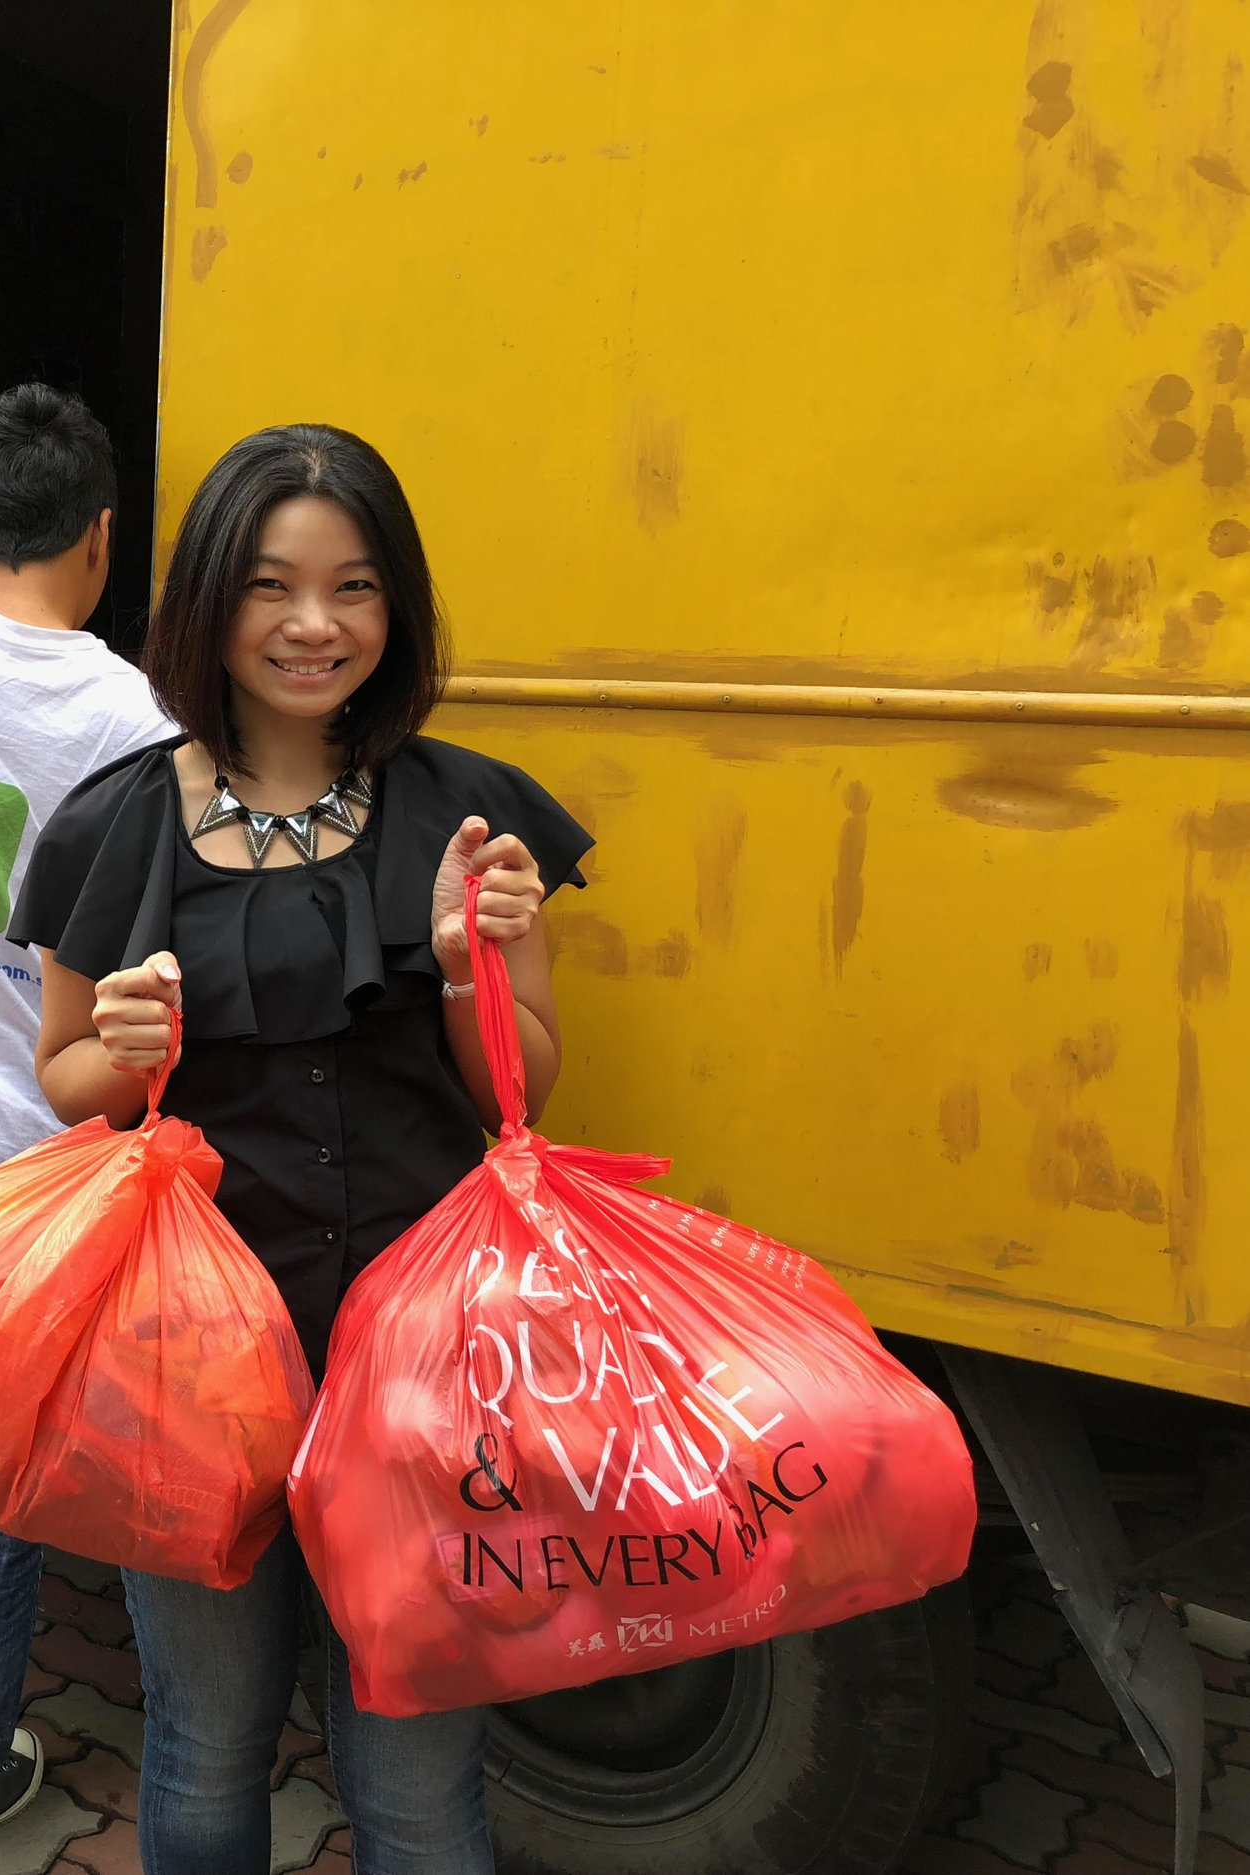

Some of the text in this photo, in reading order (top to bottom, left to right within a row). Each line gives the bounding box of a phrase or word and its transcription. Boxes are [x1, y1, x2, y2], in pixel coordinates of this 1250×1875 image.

[459, 1361, 784, 1511] & VALUE
[463, 1441, 828, 1593] IN EVERY BAG
[689, 1584, 786, 1638] METRO
